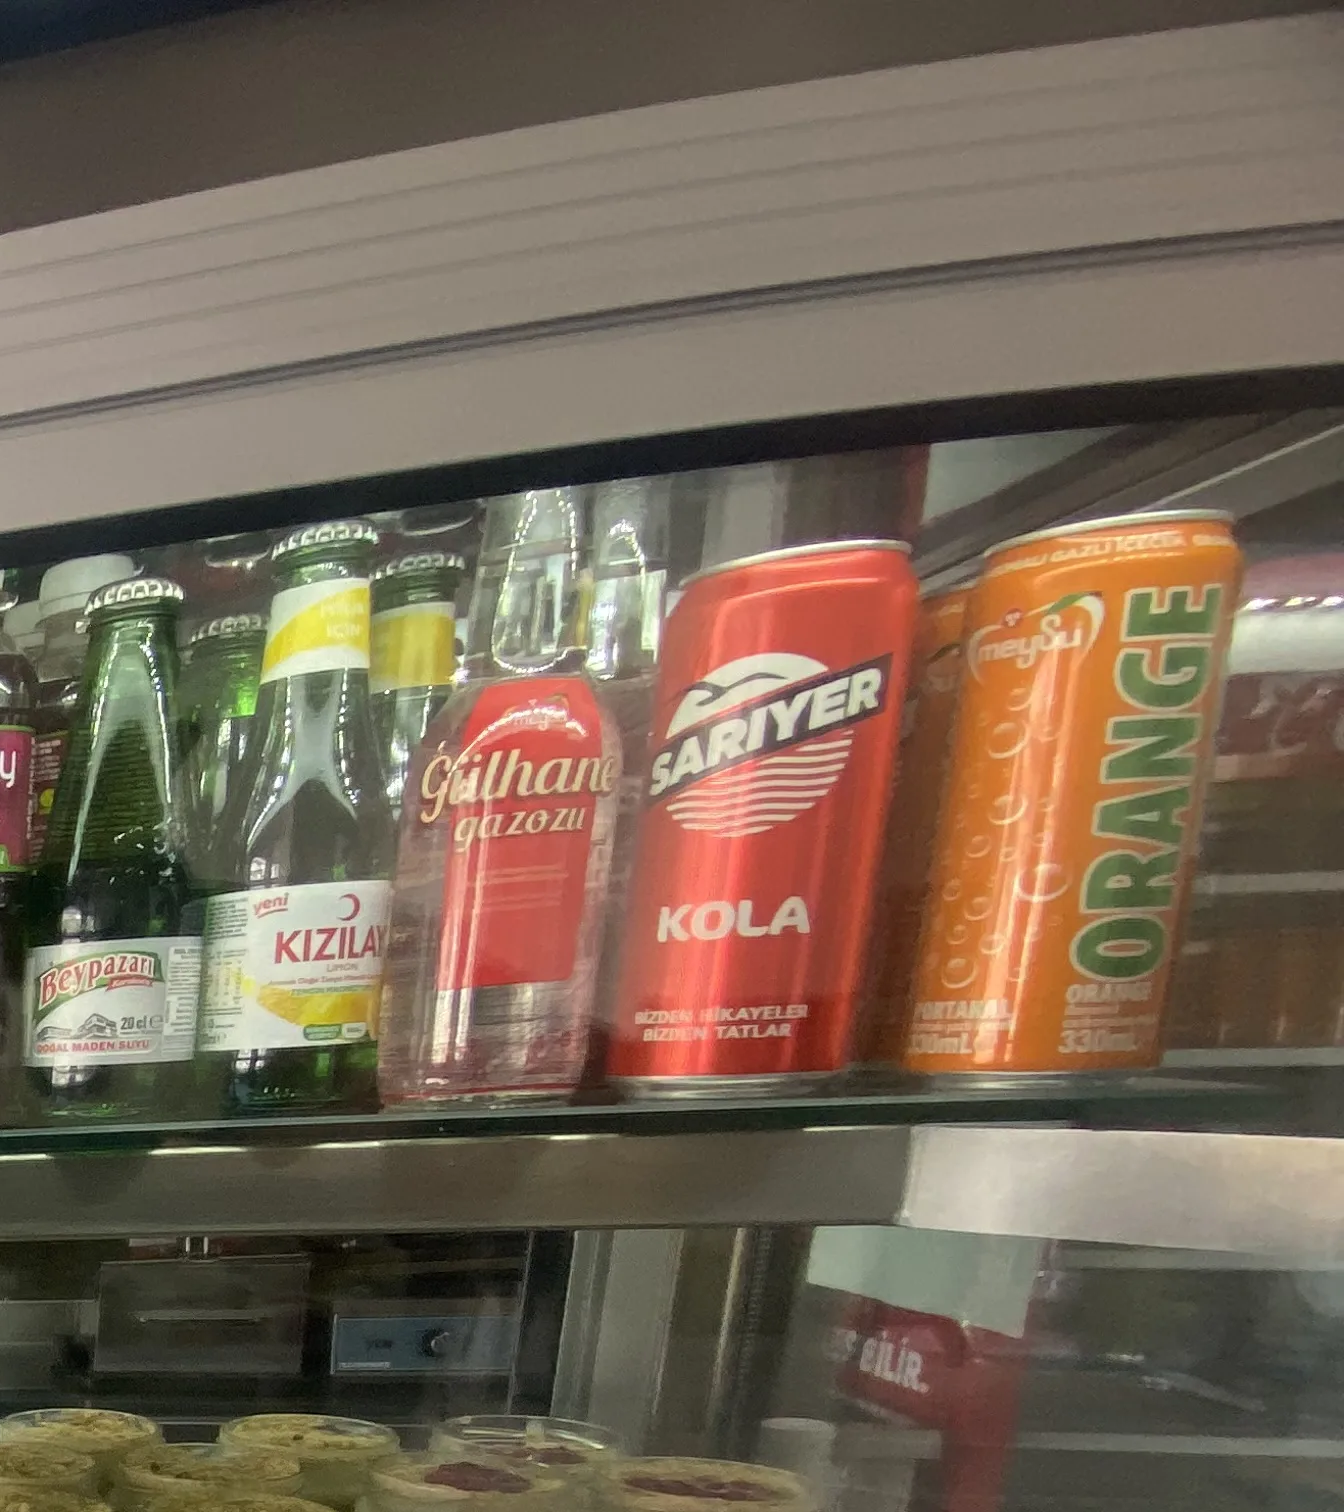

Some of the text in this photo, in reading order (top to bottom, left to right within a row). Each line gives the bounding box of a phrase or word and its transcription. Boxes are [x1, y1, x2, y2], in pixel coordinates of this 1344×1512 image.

[650, 673, 884, 797] SARIYER
[420, 742, 615, 824] Gülhane
[1067, 583, 1224, 983] ORANGE
[454, 807, 587, 853] gazozu
[656, 896, 812, 943] KOLA
[71, 1040, 112, 1052] MADEN
[118, 1038, 151, 1050] SUYU
[120, 1014, 148, 1030] 20 cl
[714, 1023, 793, 1040] TATLAR
